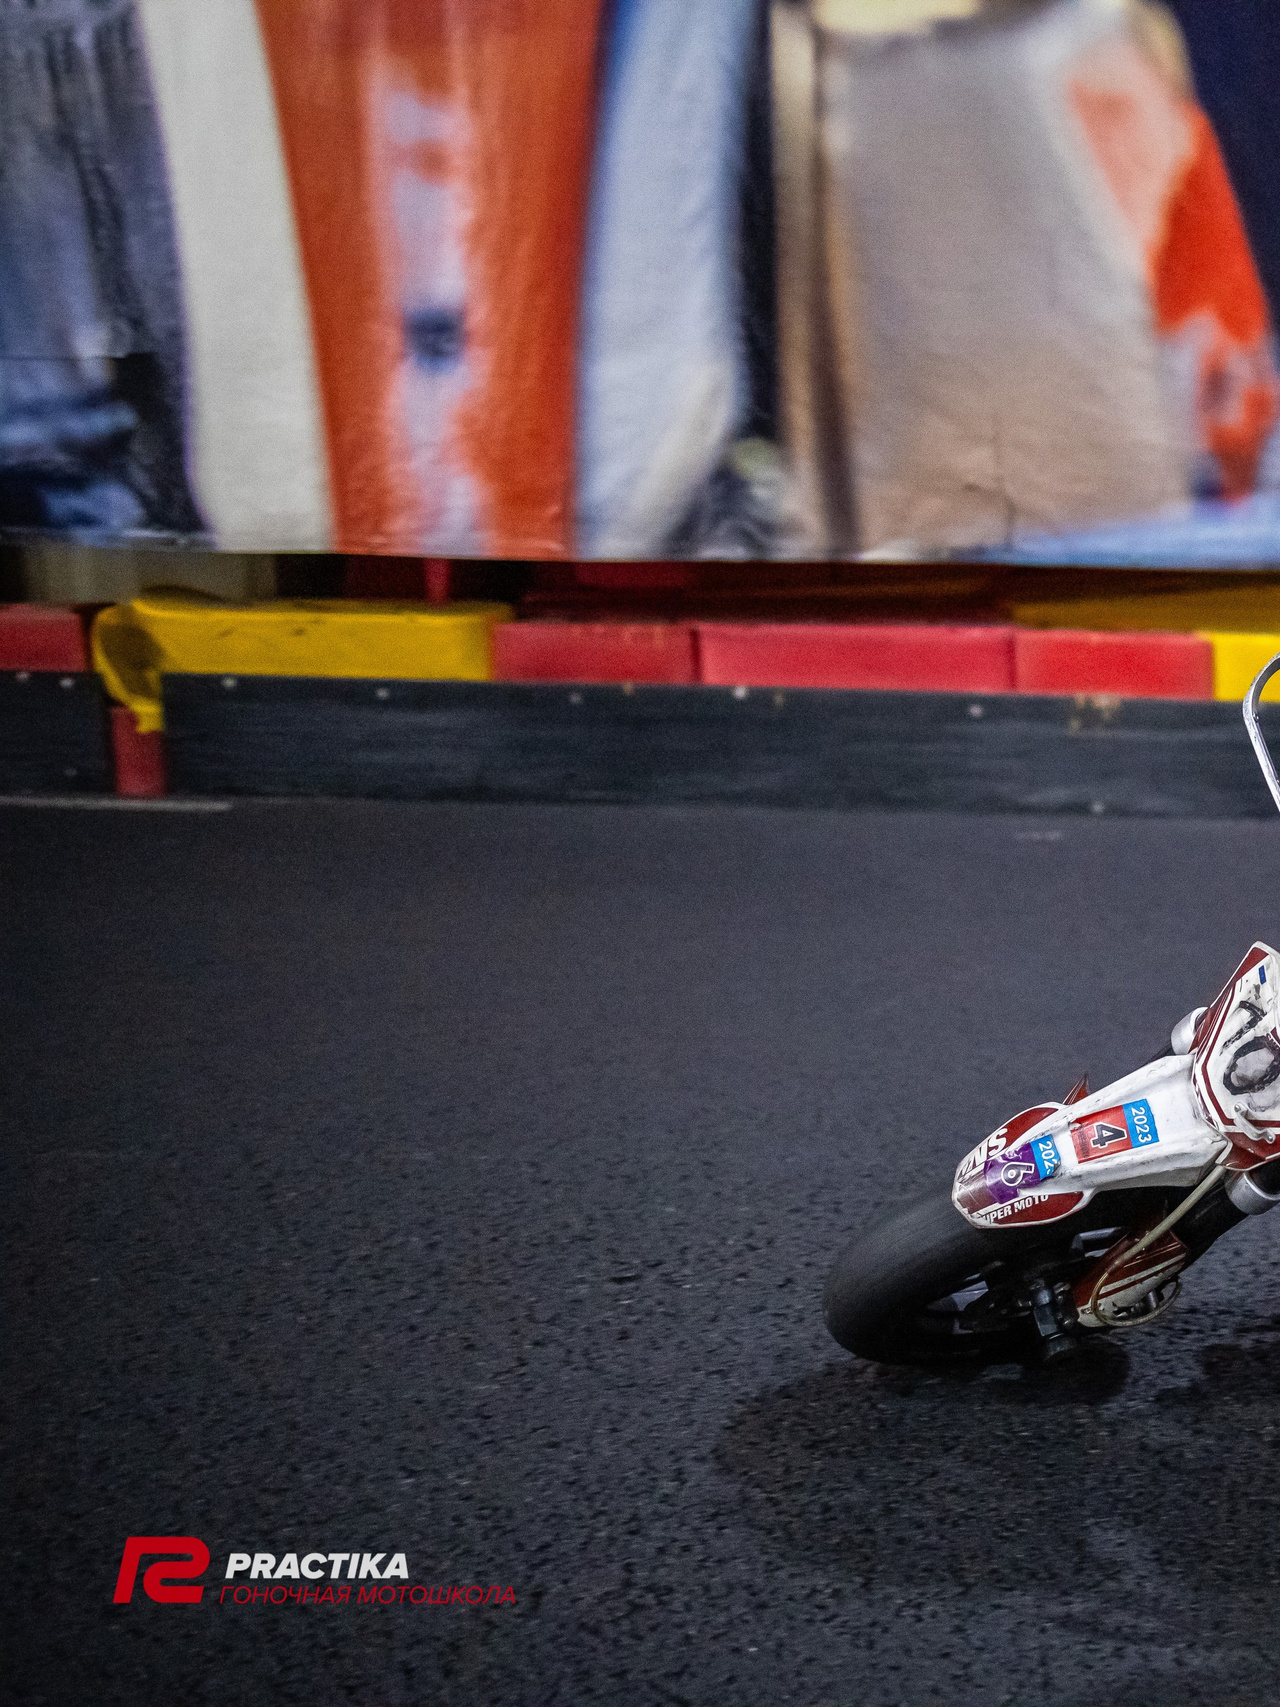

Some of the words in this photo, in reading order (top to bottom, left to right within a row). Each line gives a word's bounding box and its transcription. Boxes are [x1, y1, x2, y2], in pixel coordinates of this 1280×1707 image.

[1091, 1121, 1128, 1149] 4
[1131, 1107, 1152, 1143] 2023
[1001, 1162, 1035, 1187] 6
